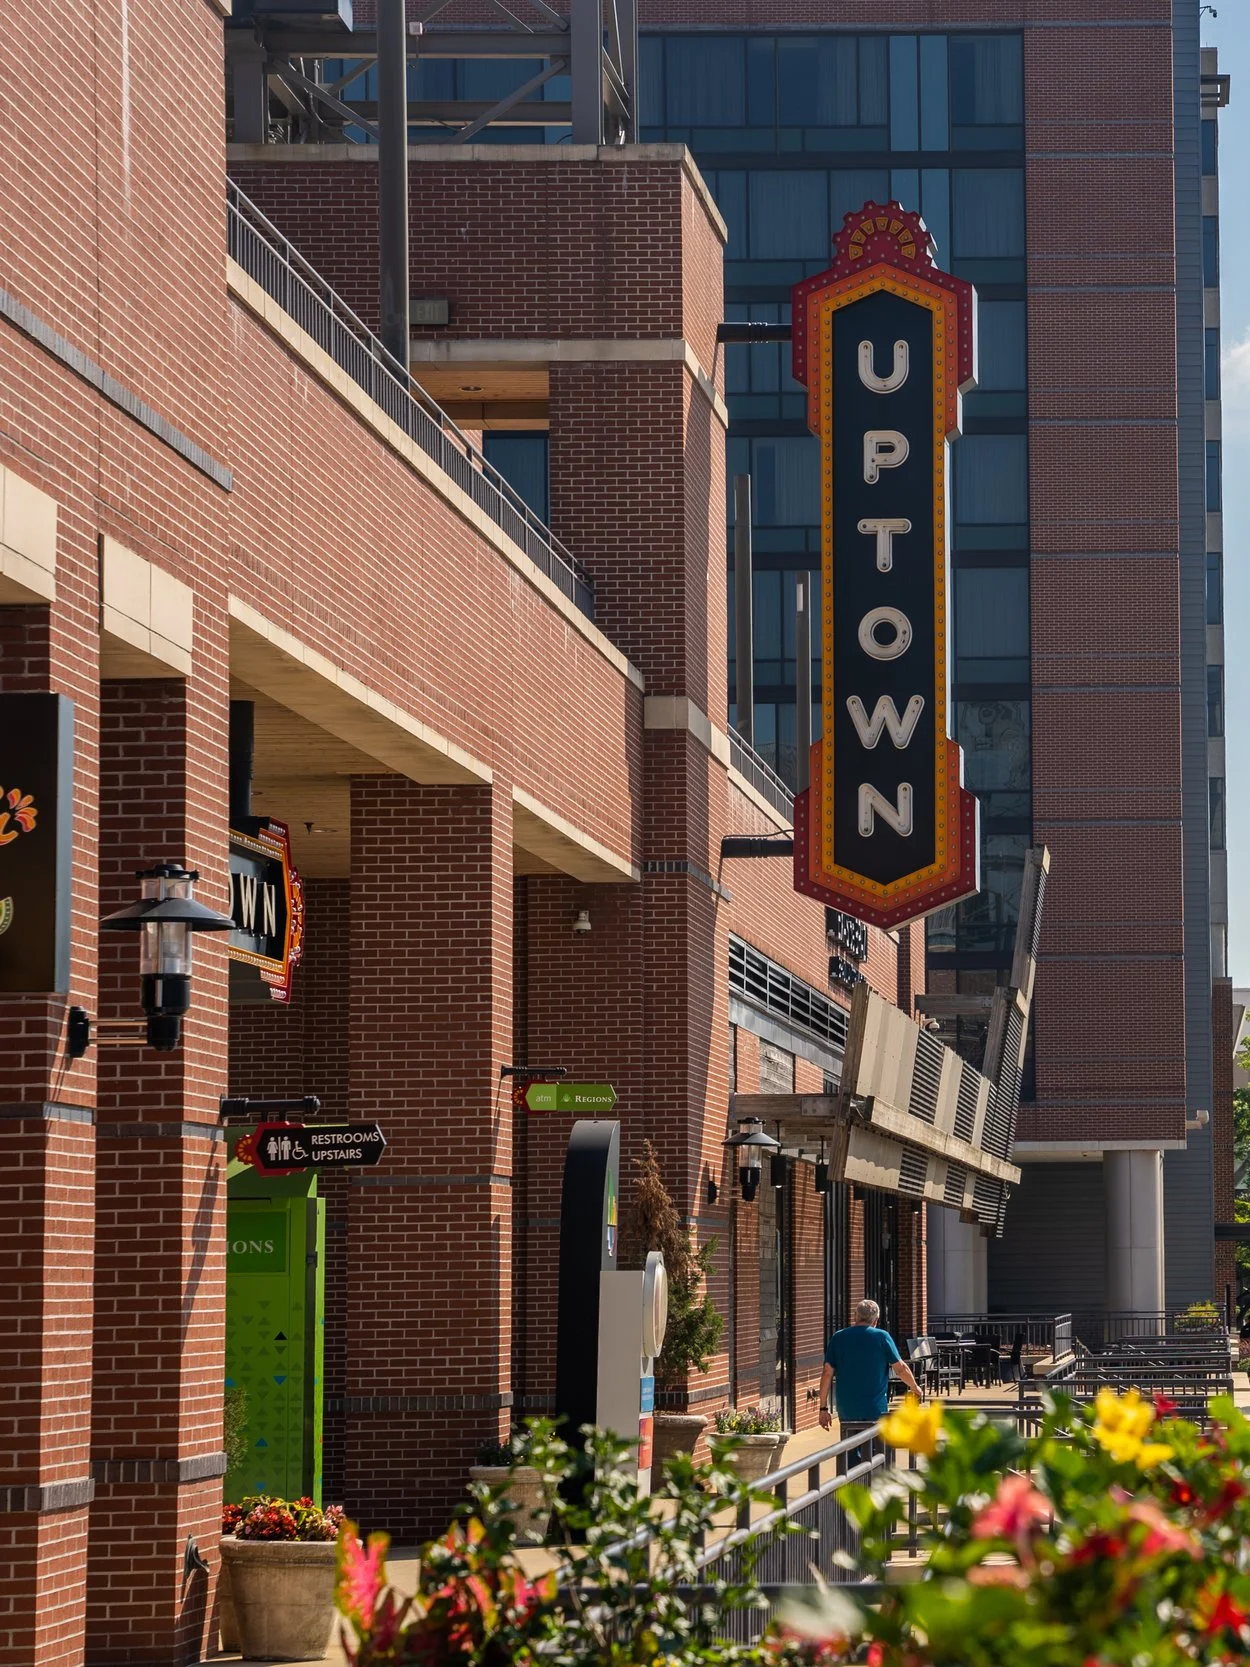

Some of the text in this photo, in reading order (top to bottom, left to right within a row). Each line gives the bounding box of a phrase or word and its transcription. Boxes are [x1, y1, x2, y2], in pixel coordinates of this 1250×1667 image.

[846, 339, 925, 838] UPTOWN
[228, 870, 277, 938] WN
[535, 1094, 612, 1103] atm REGIONS
[311, 1131, 380, 1145] RESTROOMS
[311, 1148, 362, 1161] UPSTAIRS
